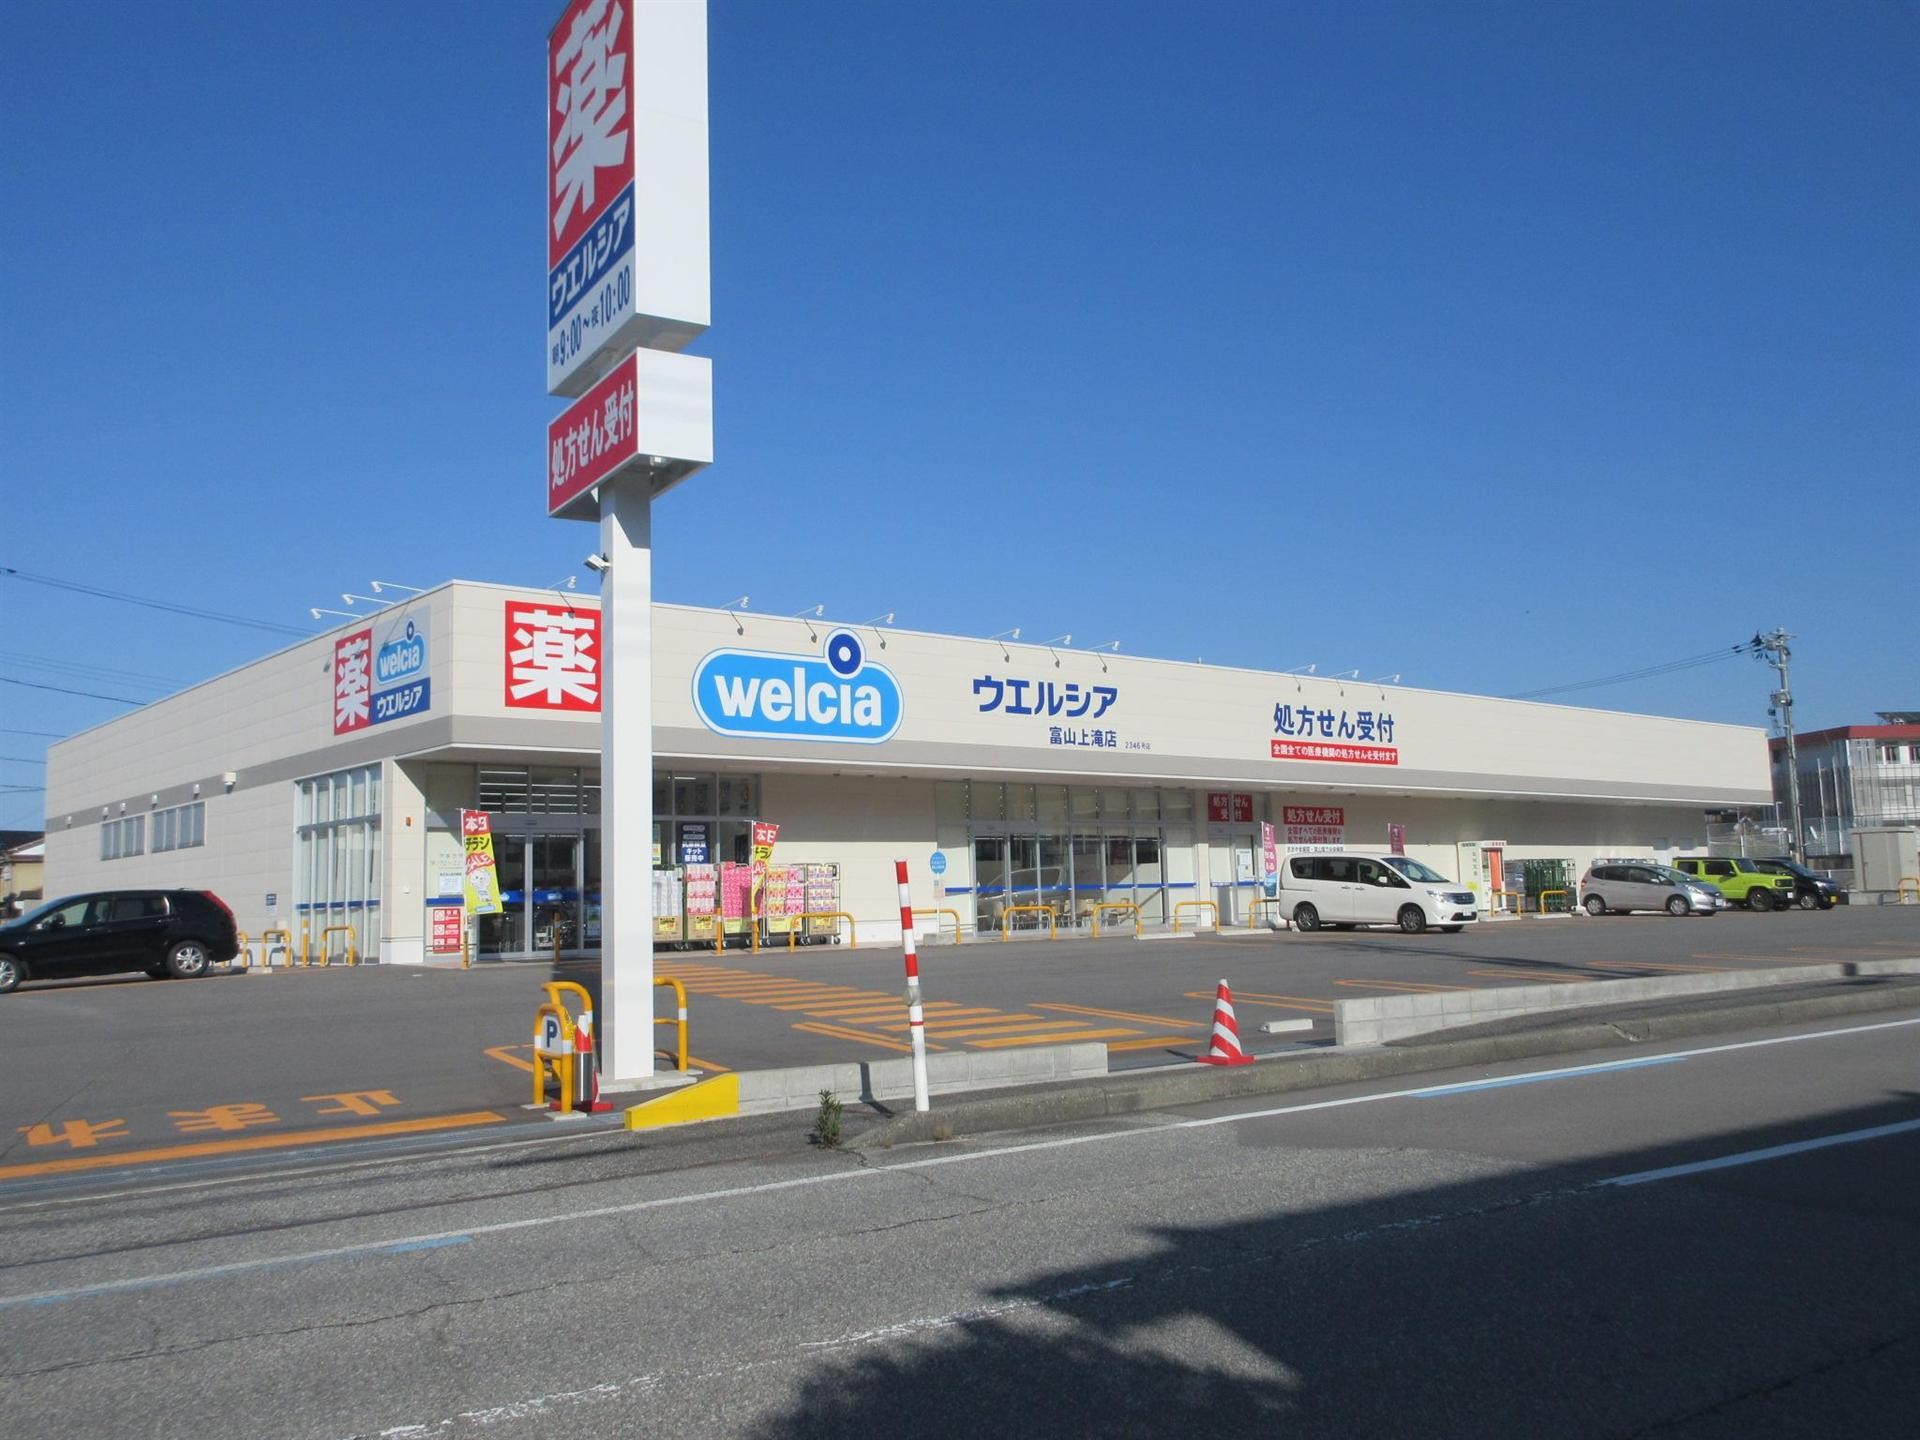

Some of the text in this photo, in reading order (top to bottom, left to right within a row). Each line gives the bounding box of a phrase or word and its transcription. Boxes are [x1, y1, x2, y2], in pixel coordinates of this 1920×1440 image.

[553, 0, 628, 241] 薬
[552, 197, 630, 317] ウエルシア
[552, 379, 634, 490] 処方せん受付
[380, 621, 420, 677] welcia
[509, 609, 598, 705] 薬
[336, 638, 370, 728] 薬
[376, 686, 423, 719] ウエルシア
[714, 633, 882, 726] welcia
[973, 675, 1117, 718] ウエルシア
[1049, 726, 1117, 748] 富山上滝店
[1273, 702, 1394, 743] 処方せん受付
[465, 815, 488, 832] 本日
[1287, 808, 1341, 823] 処方せん受付
[465, 836, 490, 851] チラシ
[546, 1020, 557, 1048] P
[18, 1089, 402, 1149] 止まれ
